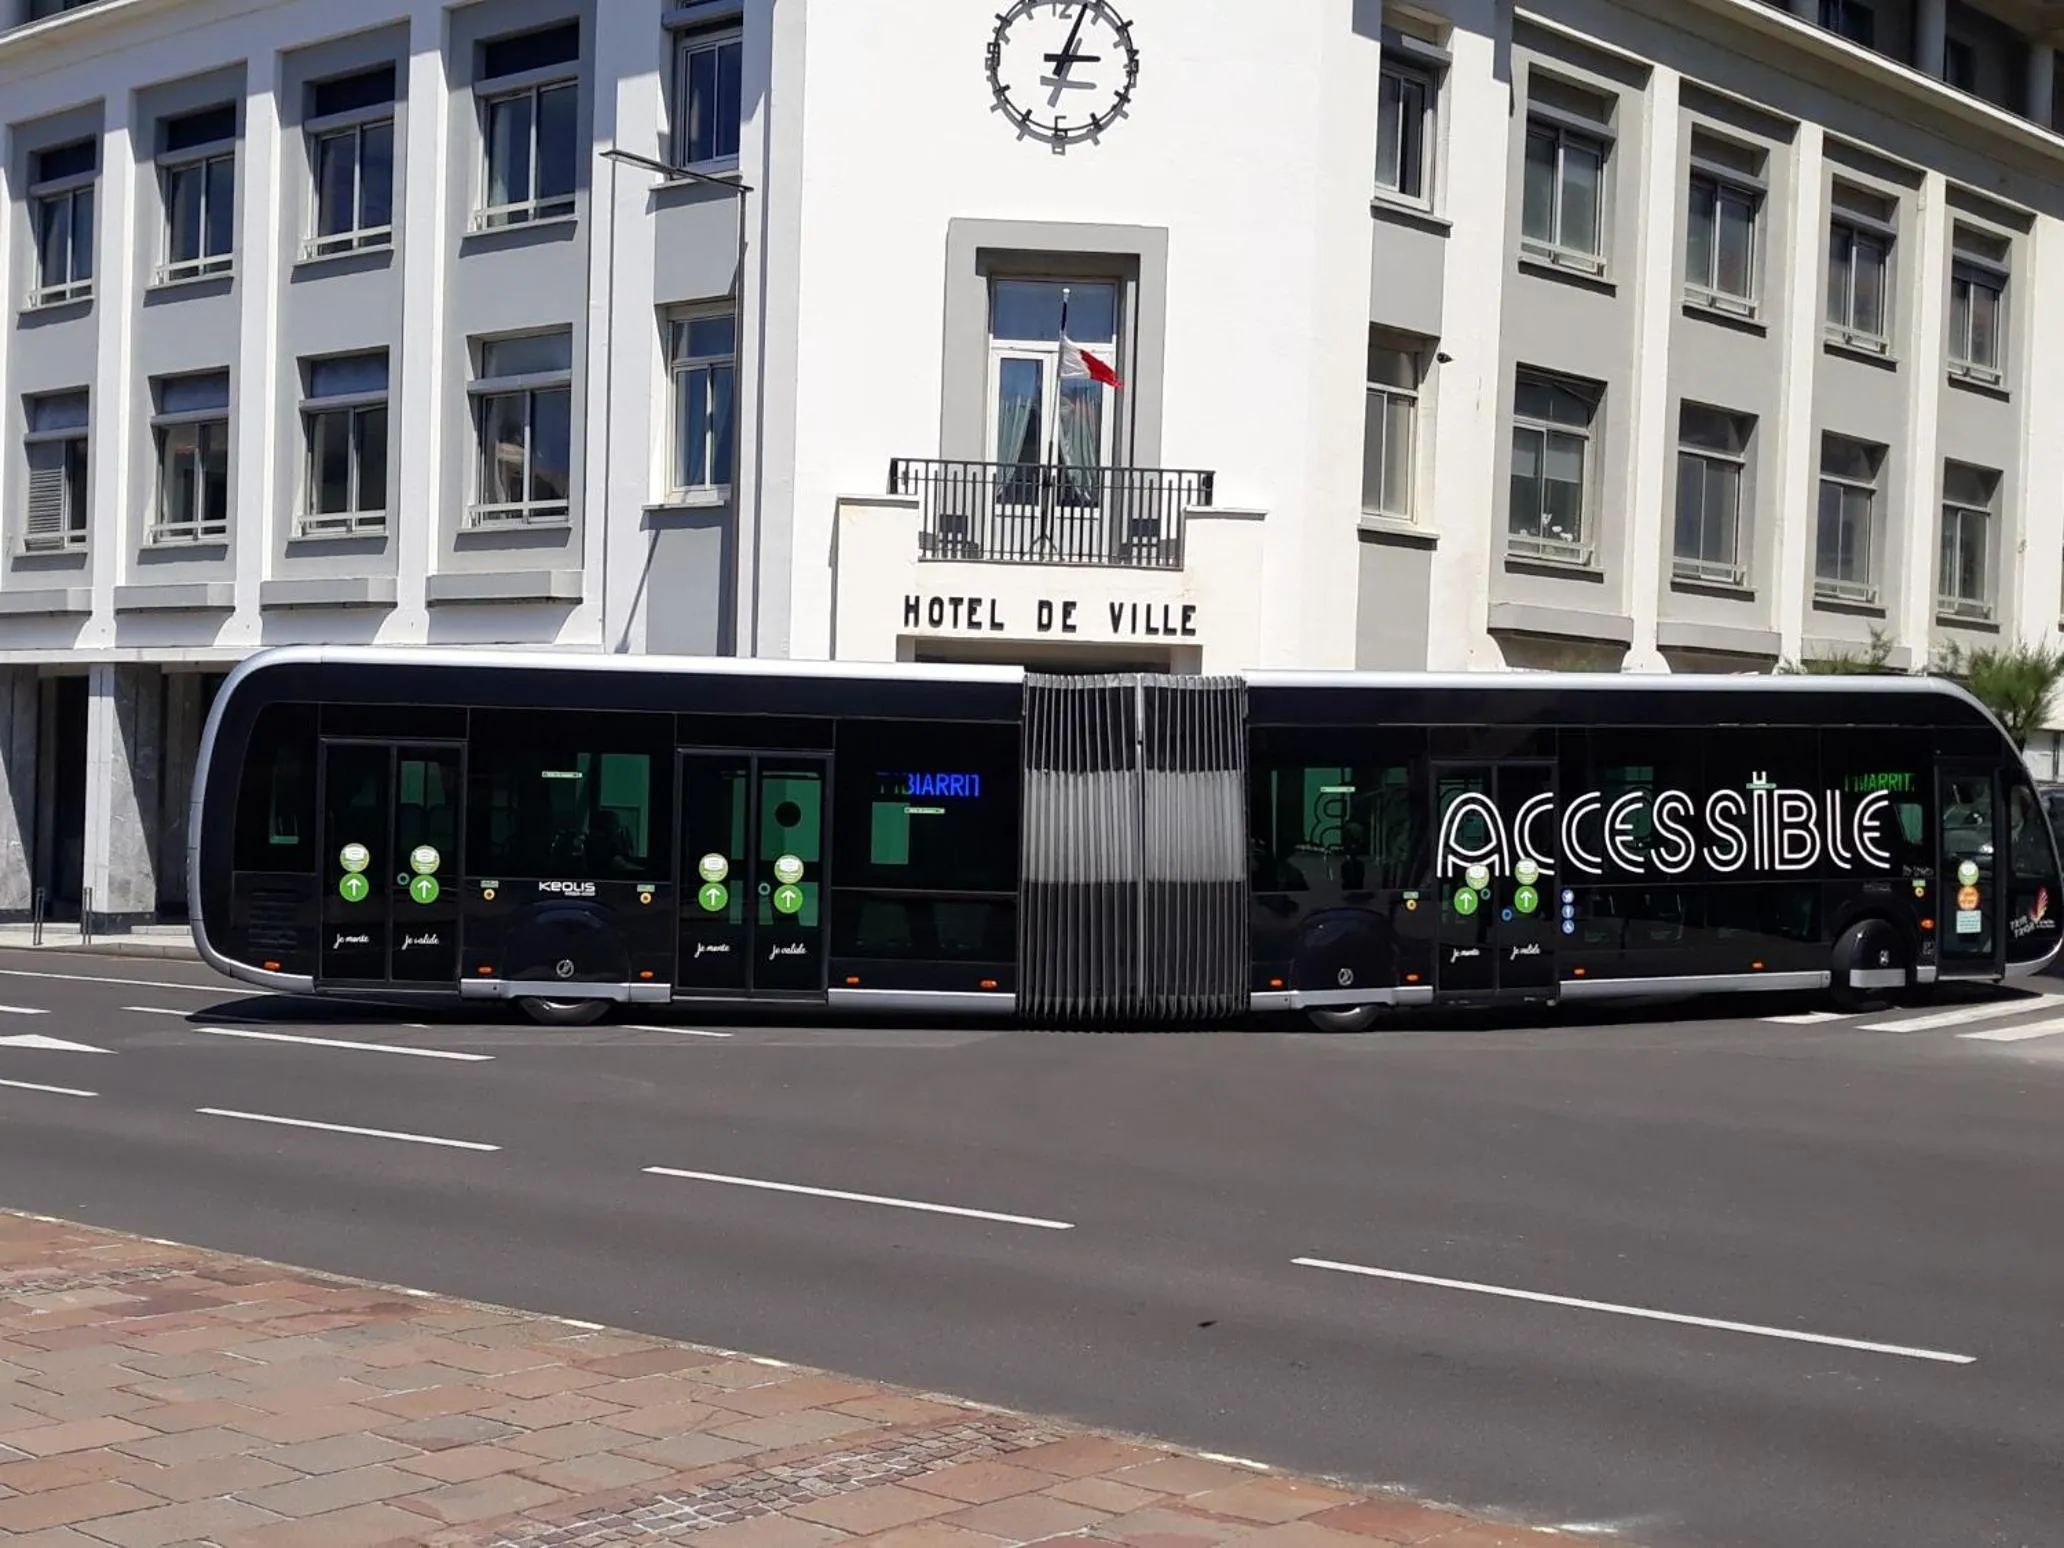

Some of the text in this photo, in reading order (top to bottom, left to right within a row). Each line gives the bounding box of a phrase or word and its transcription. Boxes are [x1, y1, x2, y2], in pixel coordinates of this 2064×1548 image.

[904, 595, 1197, 637] HOTEL DE VILLE
[1436, 771, 1892, 878] ACCESSIBLE
